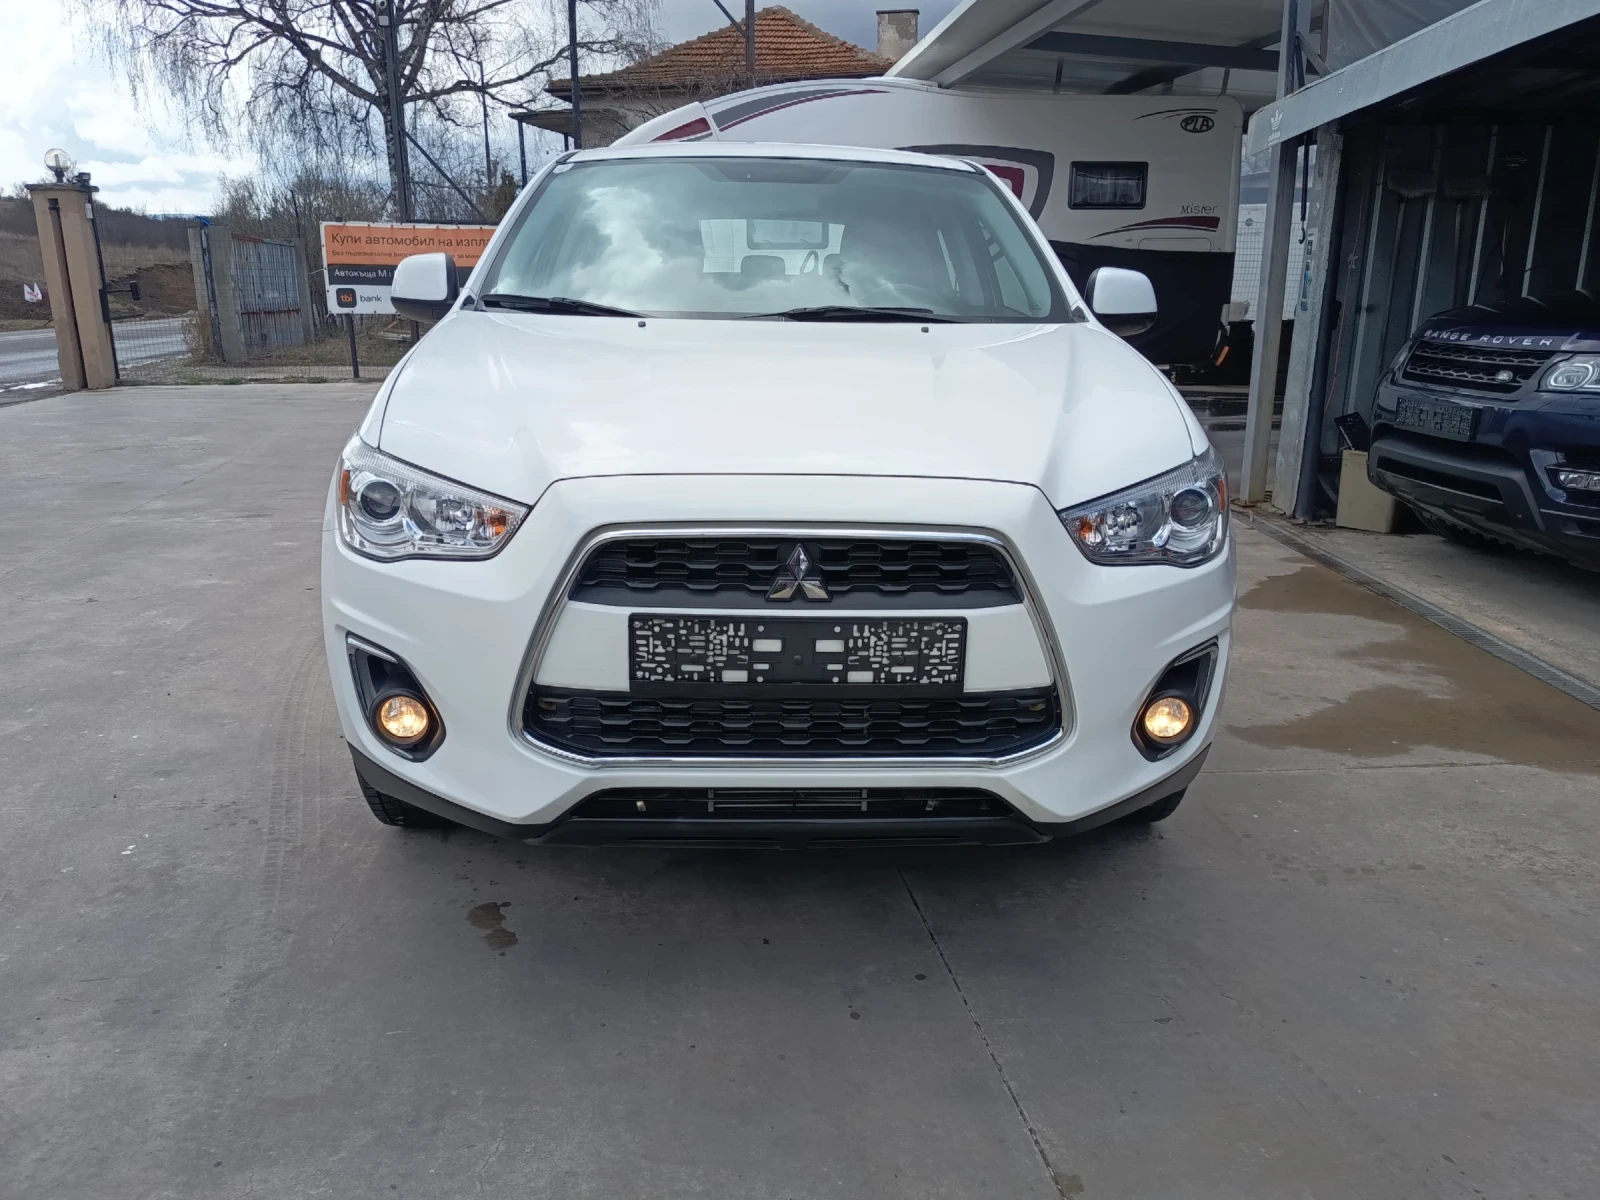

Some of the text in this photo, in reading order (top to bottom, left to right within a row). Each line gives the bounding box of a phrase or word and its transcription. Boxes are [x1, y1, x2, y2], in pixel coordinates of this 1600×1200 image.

[1183, 117, 1211, 131] PLA
[1268, 131, 1281, 142] adidas
[1181, 203, 1219, 214] Mister
[331, 232, 362, 246] Купи
[365, 235, 435, 247] автомобил
[438, 238, 453, 247] на
[334, 268, 377, 278] Автокъща
[340, 294, 382, 302] tbi bank
[1424, 329, 1553, 346] RANGE ROVER
